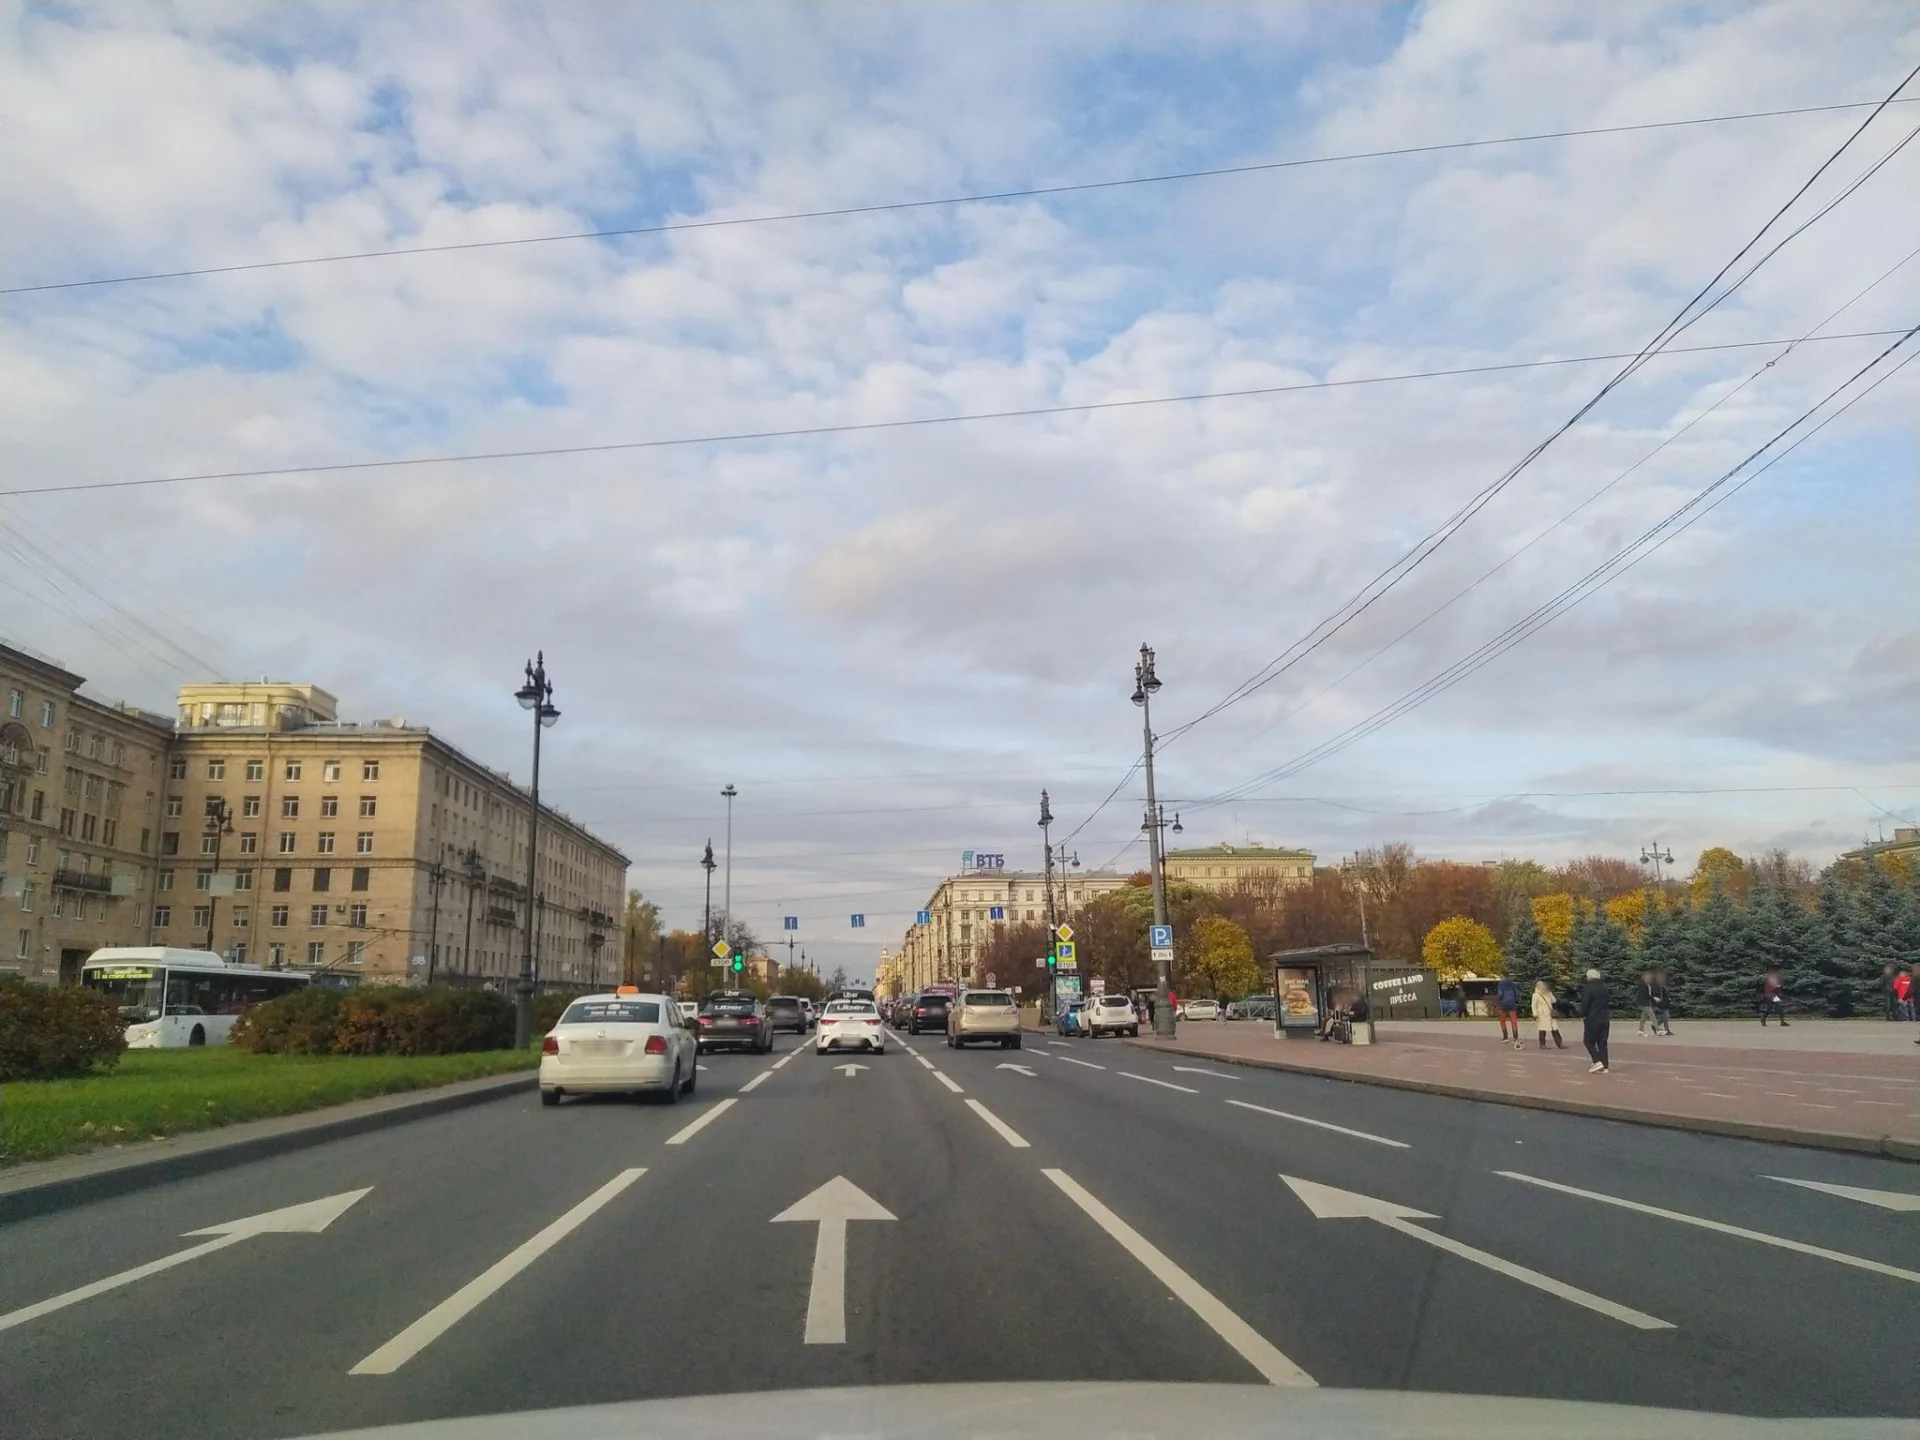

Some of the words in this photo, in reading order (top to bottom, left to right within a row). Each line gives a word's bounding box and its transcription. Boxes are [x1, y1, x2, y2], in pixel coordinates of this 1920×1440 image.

[976, 853, 1005, 868] ВТБ
[1155, 928, 1167, 946] P
[1373, 977, 1402, 990] COFFEE
[1402, 974, 1424, 985] LAND
[1389, 991, 1418, 1005] ПРЕССА
